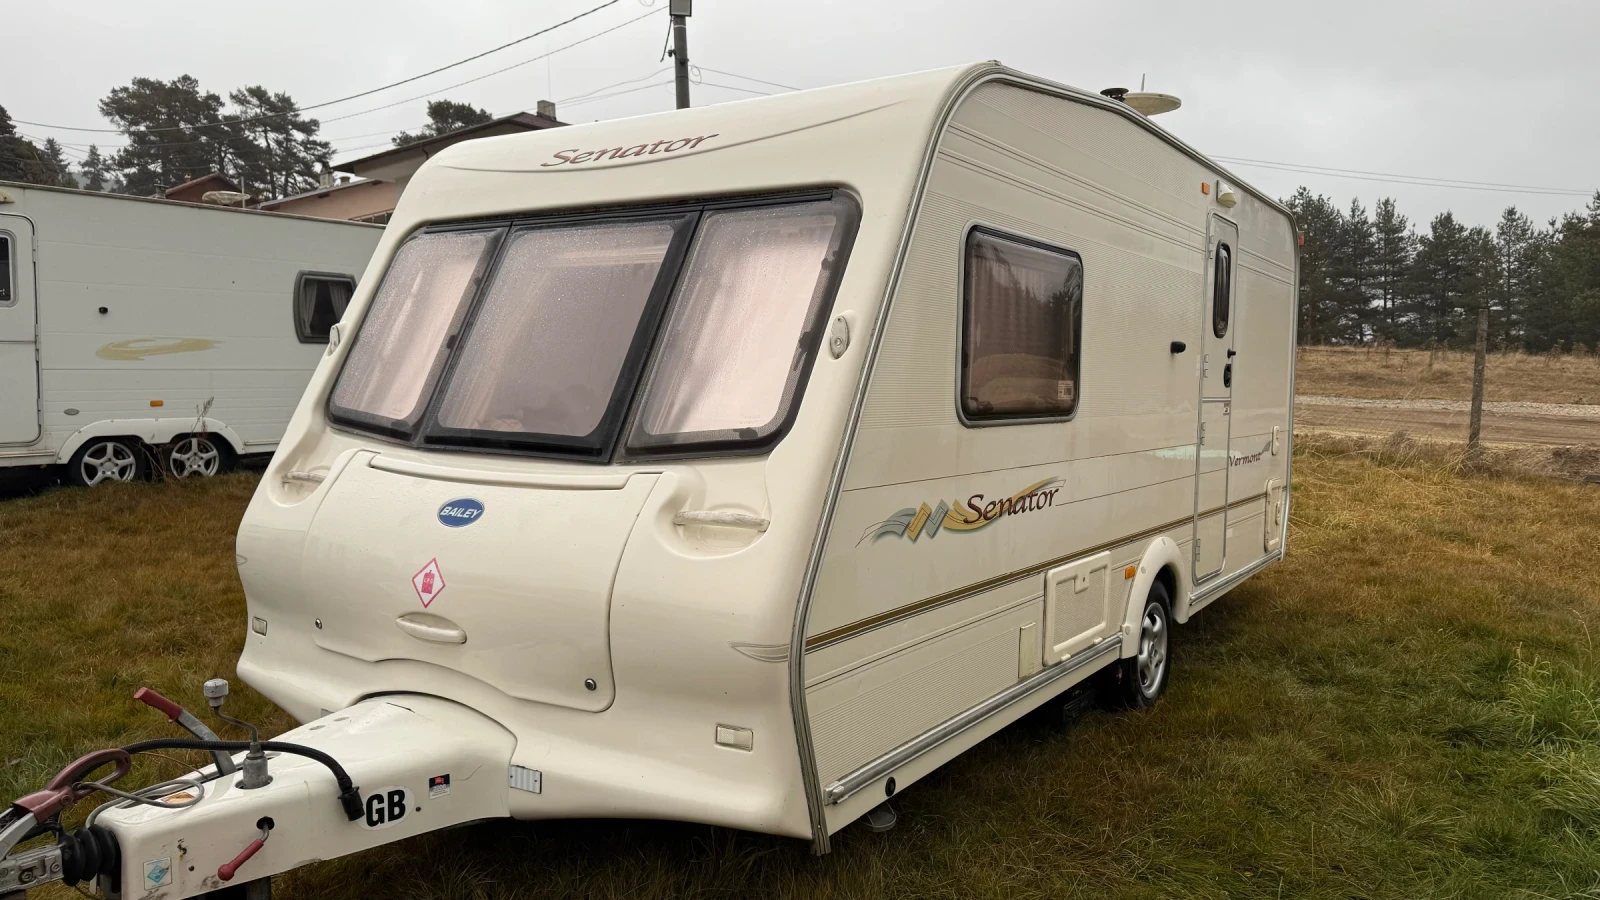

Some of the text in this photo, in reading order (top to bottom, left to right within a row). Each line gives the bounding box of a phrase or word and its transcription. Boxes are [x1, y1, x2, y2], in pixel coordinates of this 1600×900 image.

[540, 133, 720, 167] Senator
[1229, 452, 1262, 467] Vermont
[440, 506, 482, 518] BAILEY
[963, 487, 1060, 524] Senator
[366, 789, 406, 827] GB
